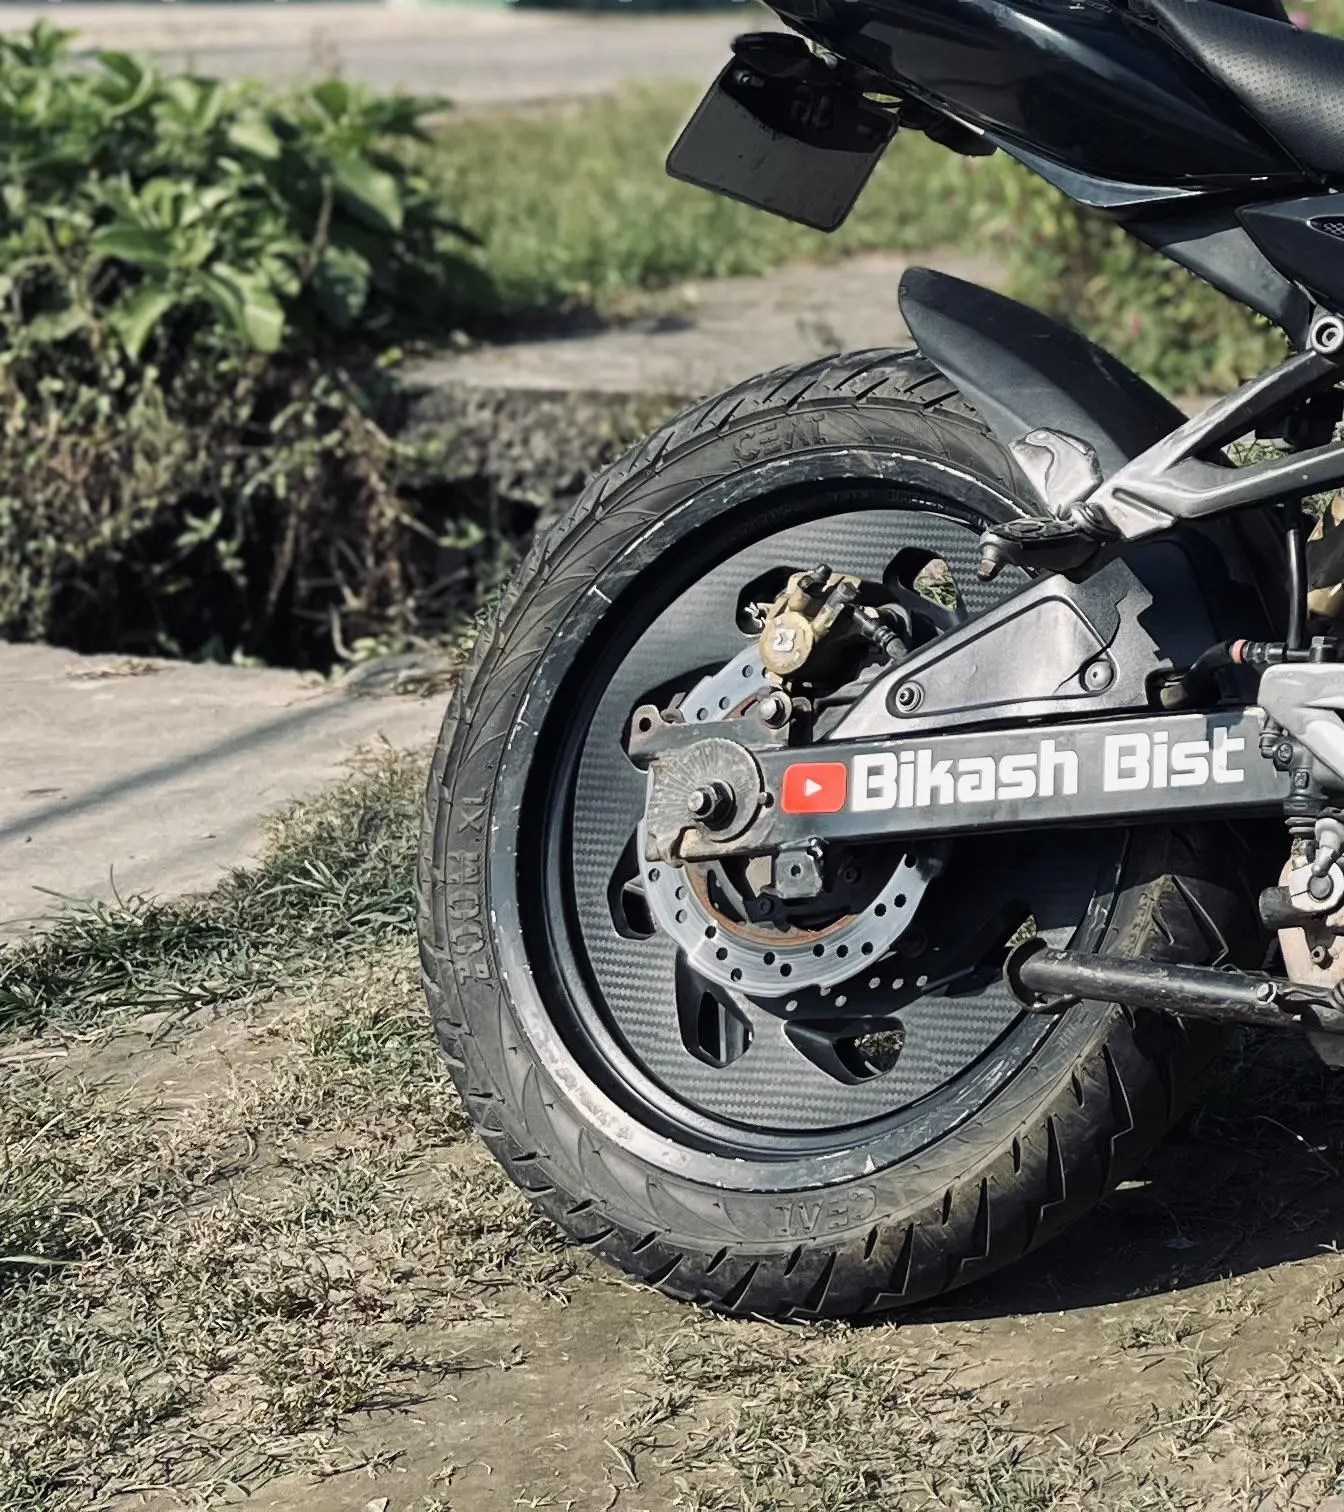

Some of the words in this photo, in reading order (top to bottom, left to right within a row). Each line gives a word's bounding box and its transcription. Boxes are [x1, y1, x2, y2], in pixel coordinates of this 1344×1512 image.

[733, 412, 828, 462] CEAT
[850, 739, 1079, 812] Bikash
[1104, 726, 1245, 792] Bist
[776, 1185, 877, 1236] CEAT
